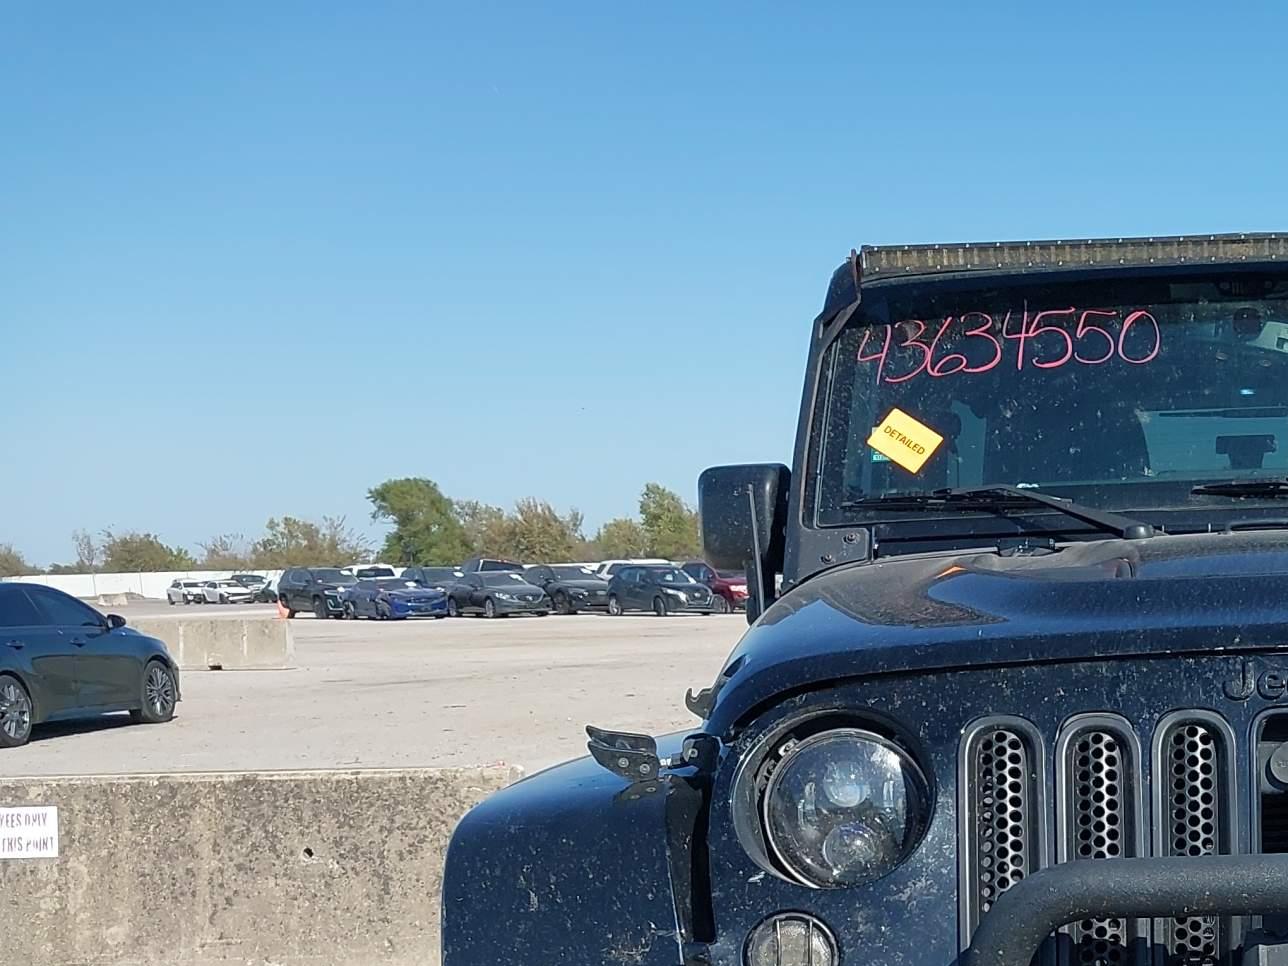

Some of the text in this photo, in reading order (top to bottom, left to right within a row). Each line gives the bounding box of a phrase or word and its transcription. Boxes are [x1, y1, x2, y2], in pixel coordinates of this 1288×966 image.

[857, 300, 1160, 386] 43634550
[883, 425, 926, 455] DETAILED
[2, 836, 23, 852] THIS
